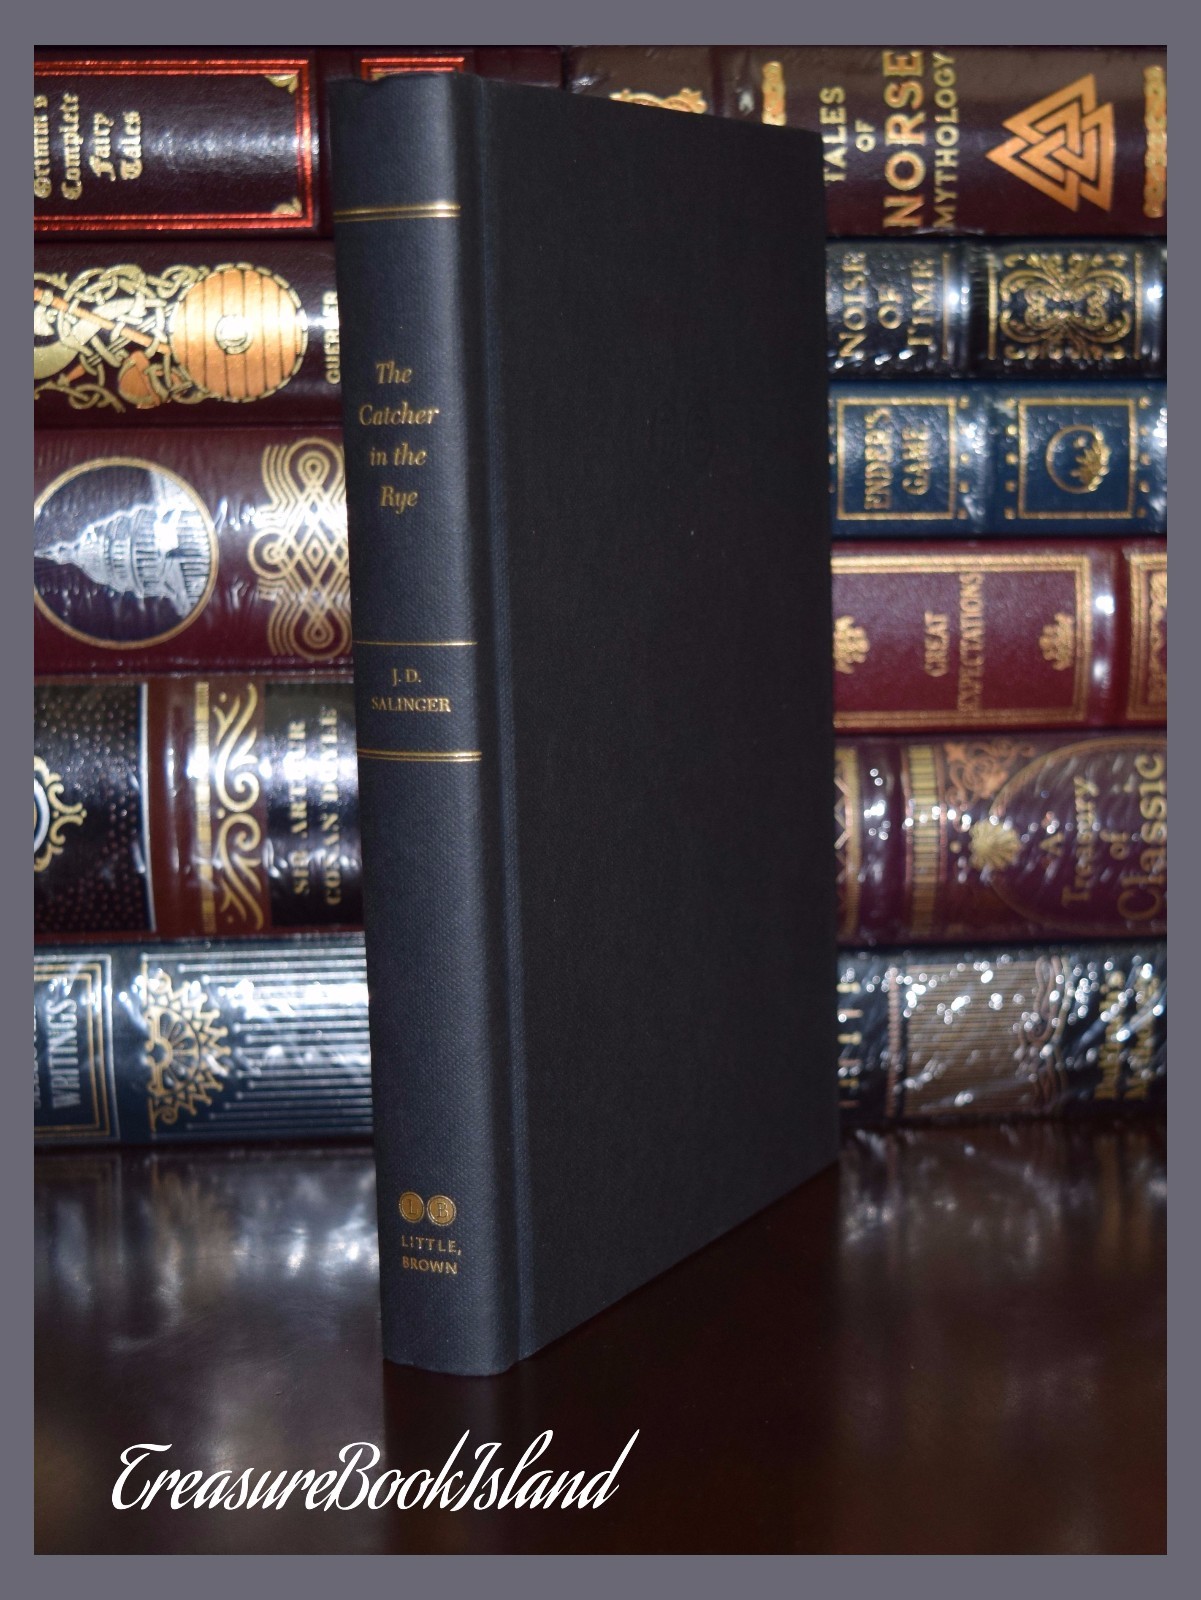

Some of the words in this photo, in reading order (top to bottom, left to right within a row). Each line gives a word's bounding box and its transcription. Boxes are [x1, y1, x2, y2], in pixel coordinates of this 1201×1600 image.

[34, 95, 52, 199] Grimms
[59, 92, 83, 200] Complete
[88, 112, 116, 182] Fairy
[119, 111, 143, 181] Tales
[820, 86, 848, 187] TALES
[855, 120, 876, 152] OF
[882, 50, 926, 228] NORSE
[933, 52, 960, 228] MYTHOLOGY
[322, 290, 341, 385] GUERER
[839, 251, 867, 358] NOISE
[878, 283, 902, 329] OF
[907, 259, 935, 346] TIME
[376, 360, 412, 385] The
[359, 401, 440, 426] Catcher
[369, 447, 388, 466] in
[394, 442, 427, 466] the
[902, 424, 932, 495] GAME
[380, 485, 418, 514] Rye
[924, 610, 950, 677] GREAT
[371, 697, 452, 713] SALINGER
[1039, 832, 1064, 857] A
[1099, 828, 1130, 861] of
[1117, 753, 1167, 921] Classic
[46, 998, 81, 1109] WRITINGS
[401, 1235, 462, 1256] LITTLE,
[402, 1255, 458, 1275] BROWN
